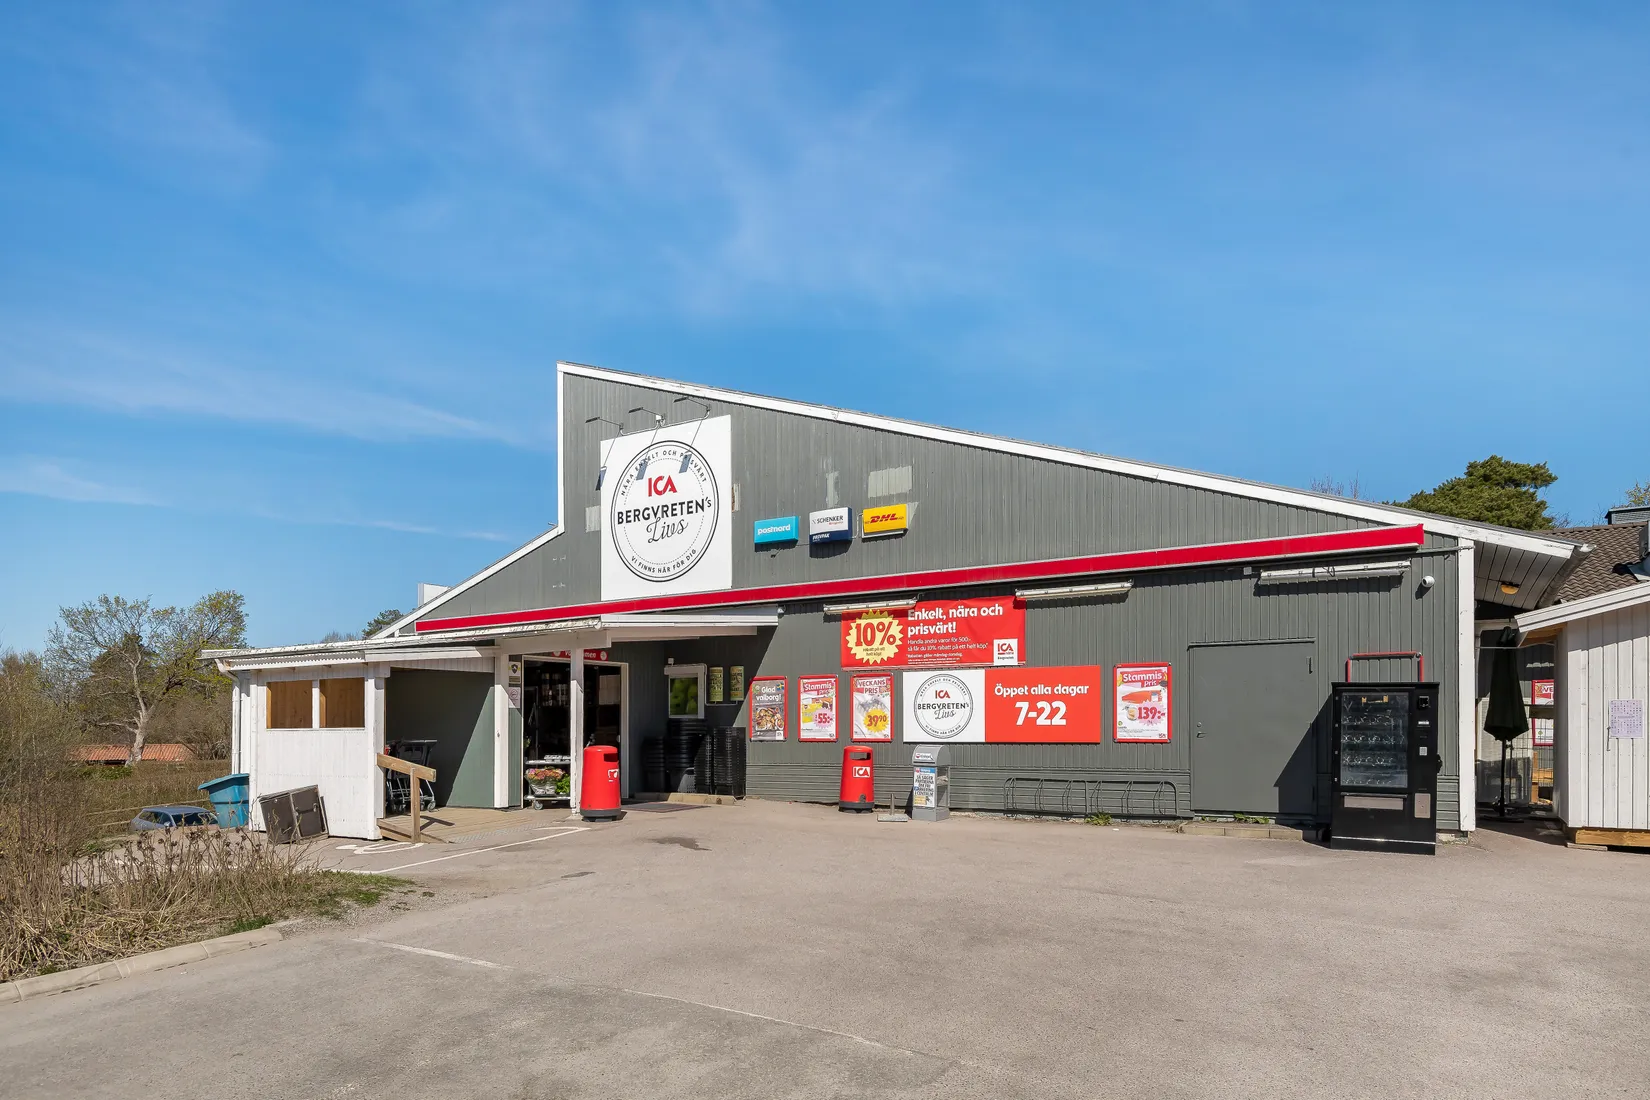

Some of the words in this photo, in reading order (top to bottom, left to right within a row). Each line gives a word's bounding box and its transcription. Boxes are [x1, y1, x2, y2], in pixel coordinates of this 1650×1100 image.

[621, 474, 634, 496] NÄRA
[648, 475, 677, 497] ICA
[817, 515, 844, 524] SCHENKER
[870, 513, 898, 524] DHL
[646, 516, 689, 543] Livs
[757, 524, 791, 535] postnord
[631, 555, 638, 564] VI
[638, 561, 656, 573] FINNS
[672, 559, 685, 570] FÖR
[685, 548, 697, 561] DIG
[908, 607, 946, 621] Enkelt,
[949, 605, 978, 618] nära
[980, 603, 1003, 616] och
[855, 621, 897, 647] 10%
[907, 621, 957, 638] prisvärt!
[997, 643, 1014, 652] ICA
[1122, 671, 1163, 682] Stammis
[804, 681, 832, 691] Stammis
[858, 679, 886, 687] VECKANS
[935, 690, 951, 699] ICA
[994, 683, 1029, 698] Öppet
[1030, 683, 1052, 695] alla
[1053, 683, 1090, 697] dagar
[755, 693, 782, 701] valborg!
[933, 708, 957, 720] Livs
[1014, 700, 1067, 726] 7-22
[1137, 706, 1166, 720] 139:-
[853, 767, 870, 777] ICA
